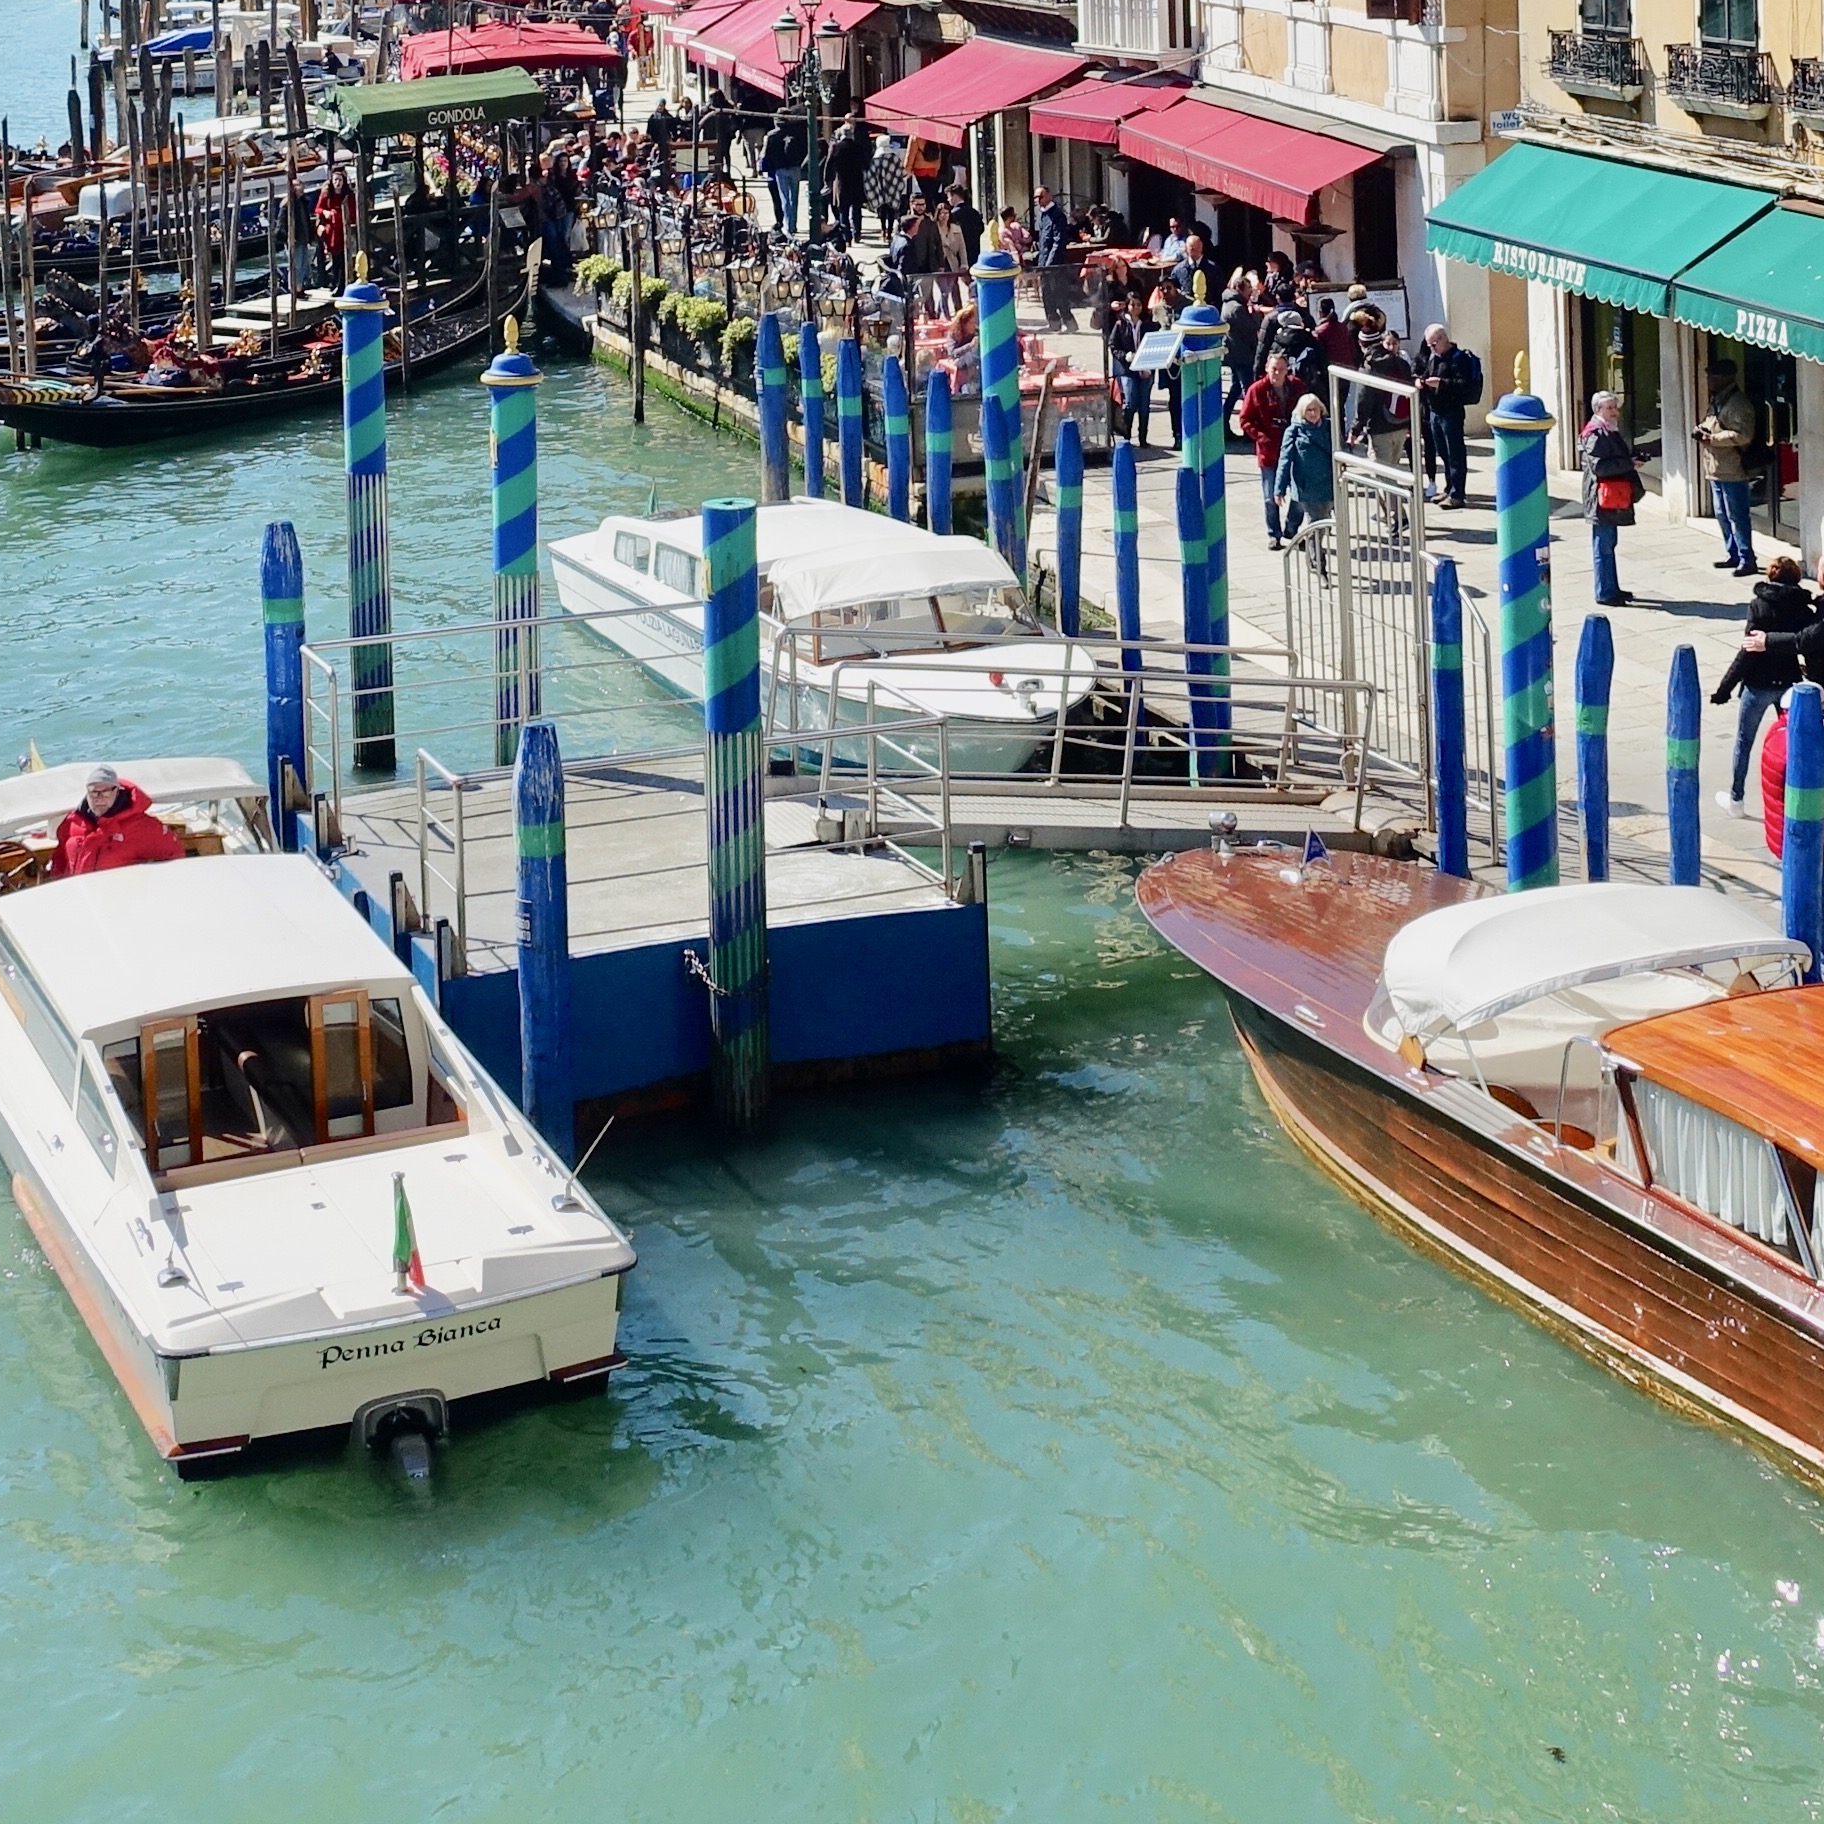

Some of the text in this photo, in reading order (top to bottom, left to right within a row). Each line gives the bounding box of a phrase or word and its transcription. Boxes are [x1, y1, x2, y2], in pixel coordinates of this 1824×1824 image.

[427, 106, 486, 125] GONDOLA
[1493, 241, 1587, 287] RISTORANTE
[1736, 308, 1788, 347] PIZZA
[316, 1315, 502, 1370] Penna Bianca
